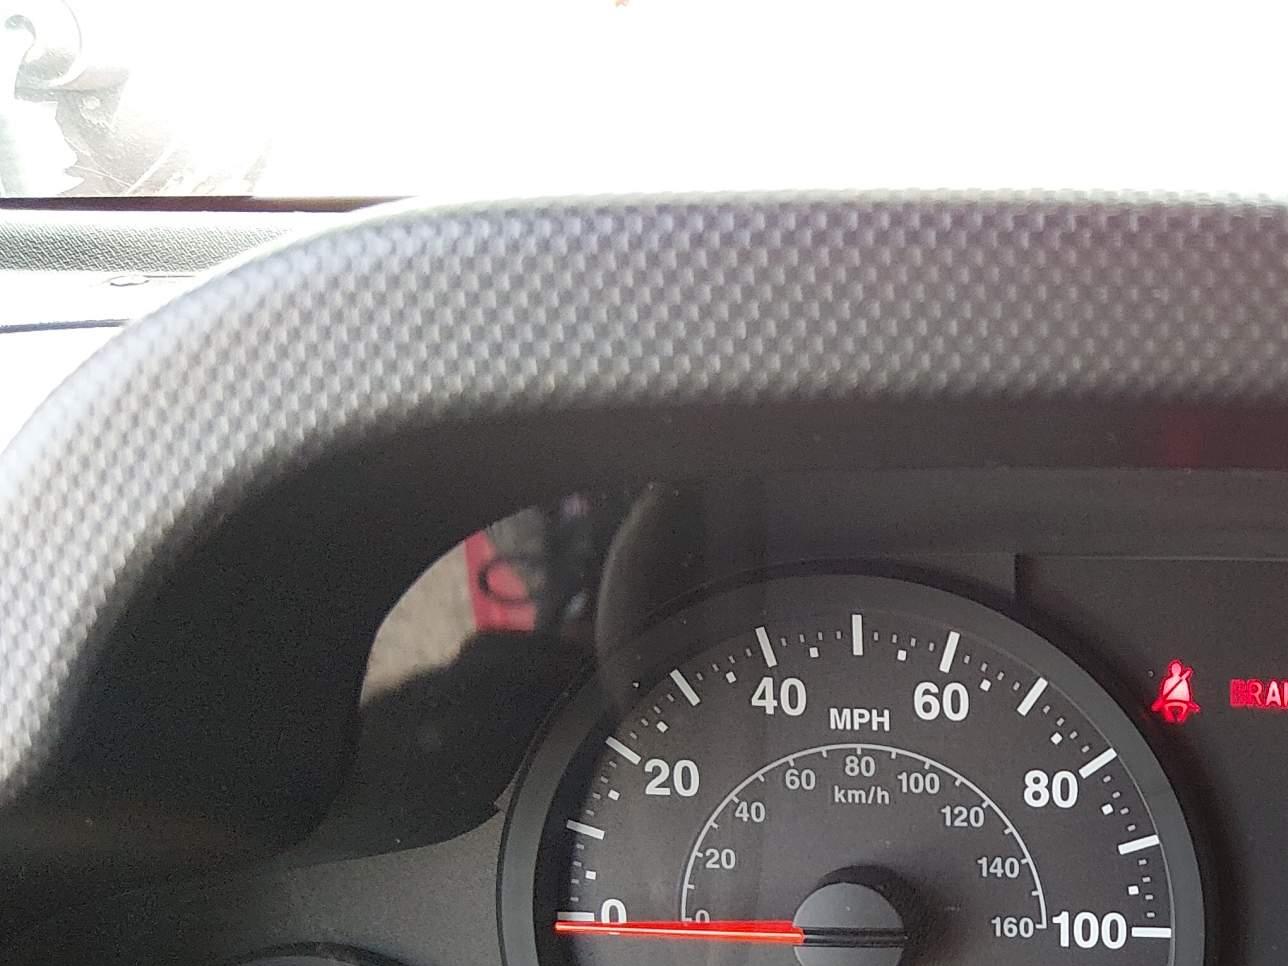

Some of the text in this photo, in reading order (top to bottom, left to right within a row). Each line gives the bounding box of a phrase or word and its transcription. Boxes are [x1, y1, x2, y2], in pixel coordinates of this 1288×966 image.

[751, 677, 807, 716] 40
[913, 681, 969, 721] 60
[829, 708, 890, 732] MPH
[644, 758, 700, 797] 20
[785, 764, 816, 790] 60
[845, 755, 876, 777] 80
[833, 784, 890, 806] km/h
[897, 771, 940, 795] 100
[1023, 768, 1079, 809] 80
[735, 800, 766, 823] 40
[941, 803, 985, 828] 120
[704, 848, 736, 870] 20
[977, 856, 1020, 878] 140
[601, 899, 627, 935] 0
[991, 916, 1034, 938] 160
[1052, 911, 1127, 950] 100
